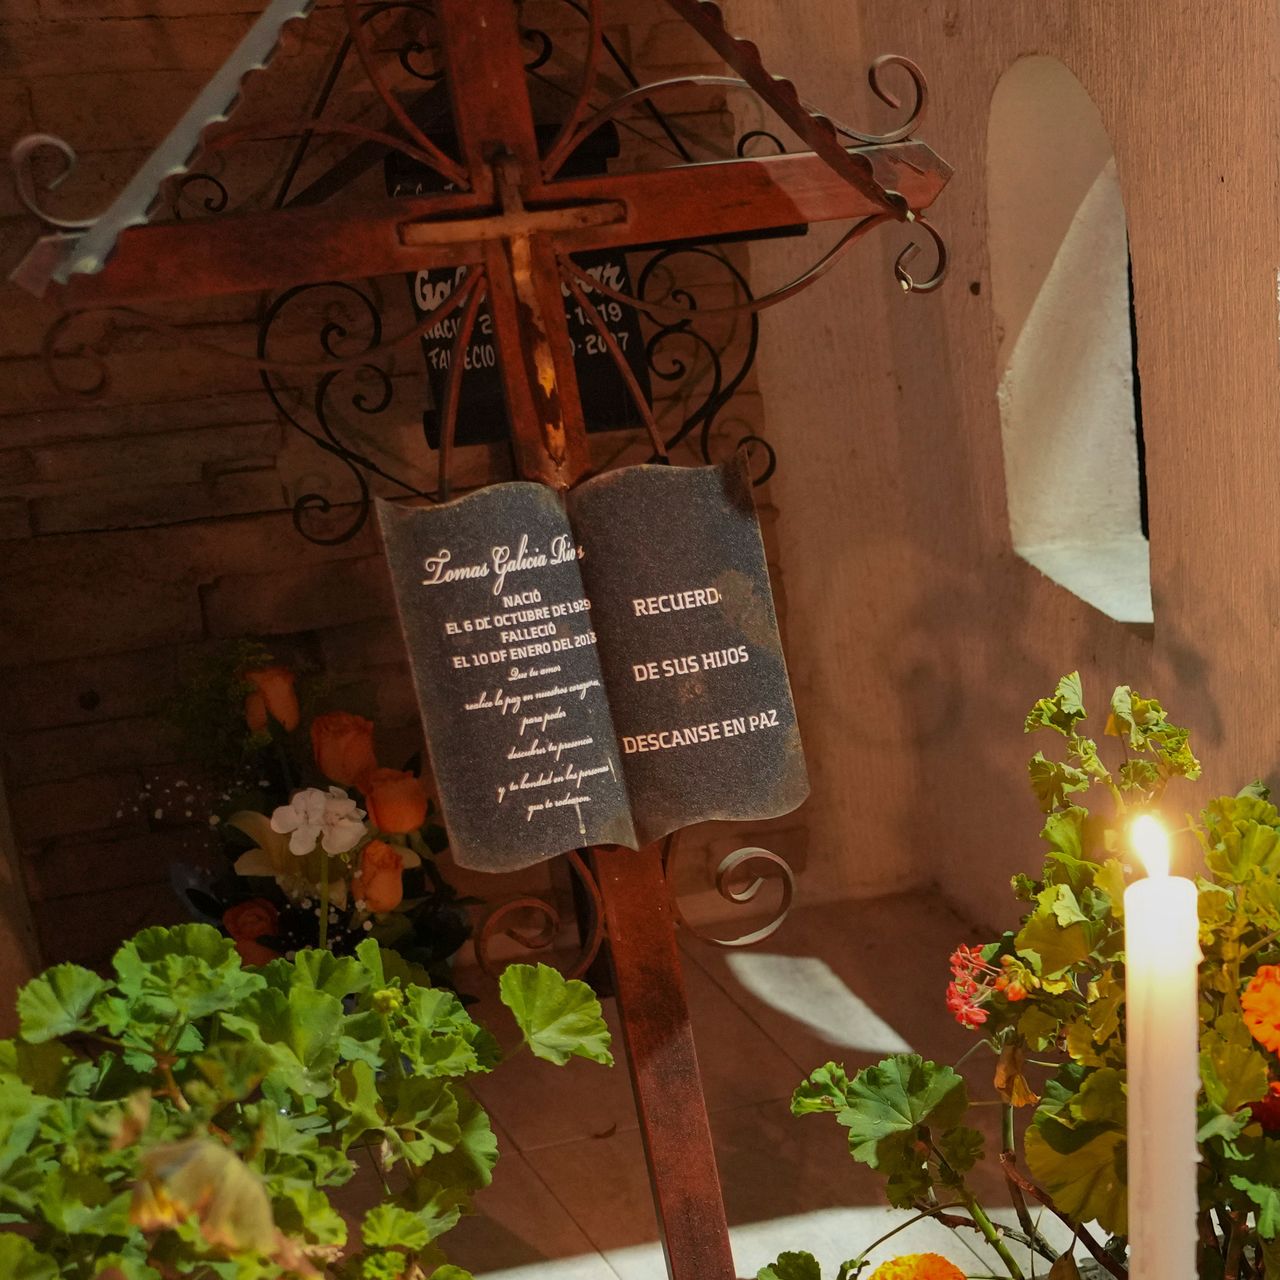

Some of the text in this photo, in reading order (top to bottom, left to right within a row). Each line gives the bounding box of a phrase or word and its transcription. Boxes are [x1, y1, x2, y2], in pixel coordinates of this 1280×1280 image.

[424, 316, 466, 340] ACI
[427, 344, 496, 371] FAECIO
[422, 548, 490, 586] Tomas
[492, 533, 548, 596] Galicia
[503, 588, 542, 608] NACIÓ
[633, 587, 723, 617] RECUERD
[446, 621, 463, 635] EL
[464, 620, 474, 633] 6
[494, 607, 551, 627] OCTUBRE
[552, 604, 567, 618] DE
[567, 598, 592, 615] 1929
[500, 621, 558, 643] FALLECIÓ
[453, 654, 470, 668] EL
[472, 652, 488, 666] 10
[510, 640, 551, 660] ENERO
[552, 638, 573, 652] DEL
[575, 631, 598, 648] 2013
[633, 646, 749, 682] DE SUS HIJOS
[507, 664, 562, 681] Que tu amor
[494, 688, 504, 706] la
[502, 695, 521, 716] paz
[522, 692, 534, 702] en
[520, 706, 567, 736] para poder
[622, 709, 780, 754] DESCANSE EN PAZ
[548, 743, 557, 753] tu
[556, 735, 594, 761] presencia
[498, 786, 506, 803] y
[509, 781, 519, 792] tu
[520, 771, 553, 789] bondad
[553, 774, 564, 783] en
[565, 763, 579, 779] las
[527, 803, 544, 822] que
